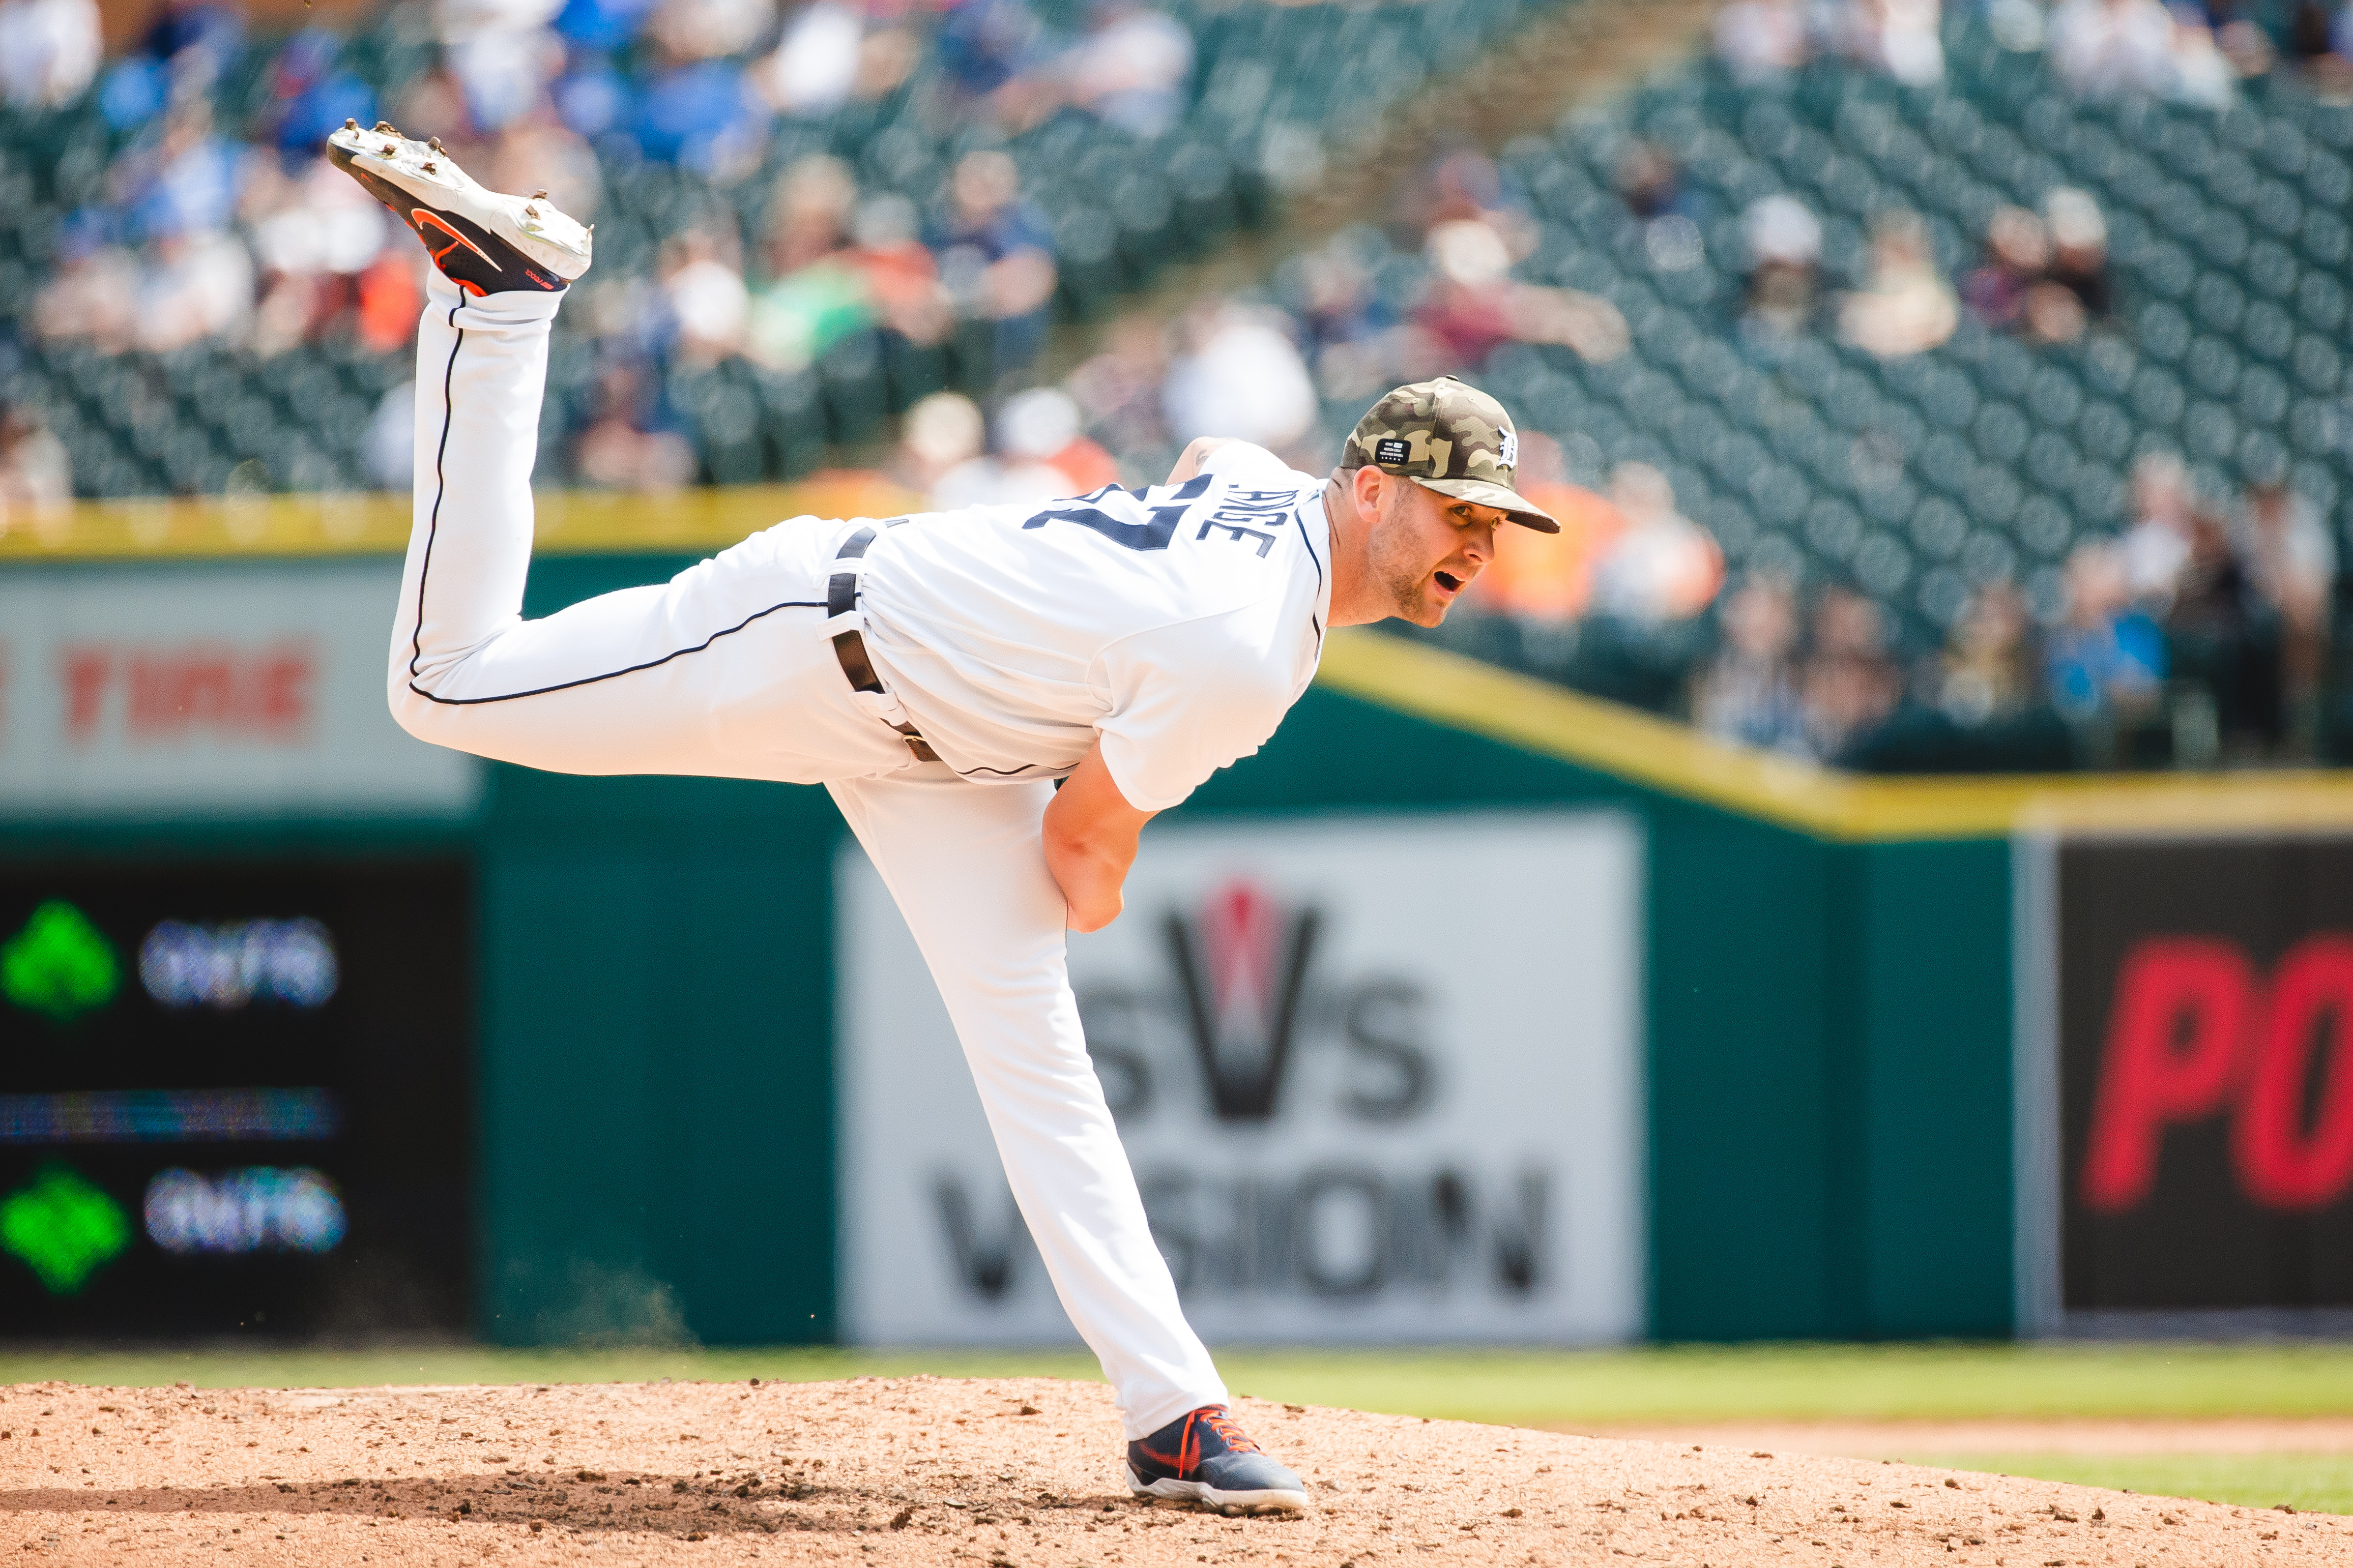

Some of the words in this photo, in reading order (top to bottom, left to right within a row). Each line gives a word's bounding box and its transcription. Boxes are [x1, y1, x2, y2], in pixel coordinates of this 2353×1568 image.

[1196, 484, 1300, 558] ANGE
[2081, 931, 2353, 1215] PO
[932, 1165, 1555, 1298] VSION
